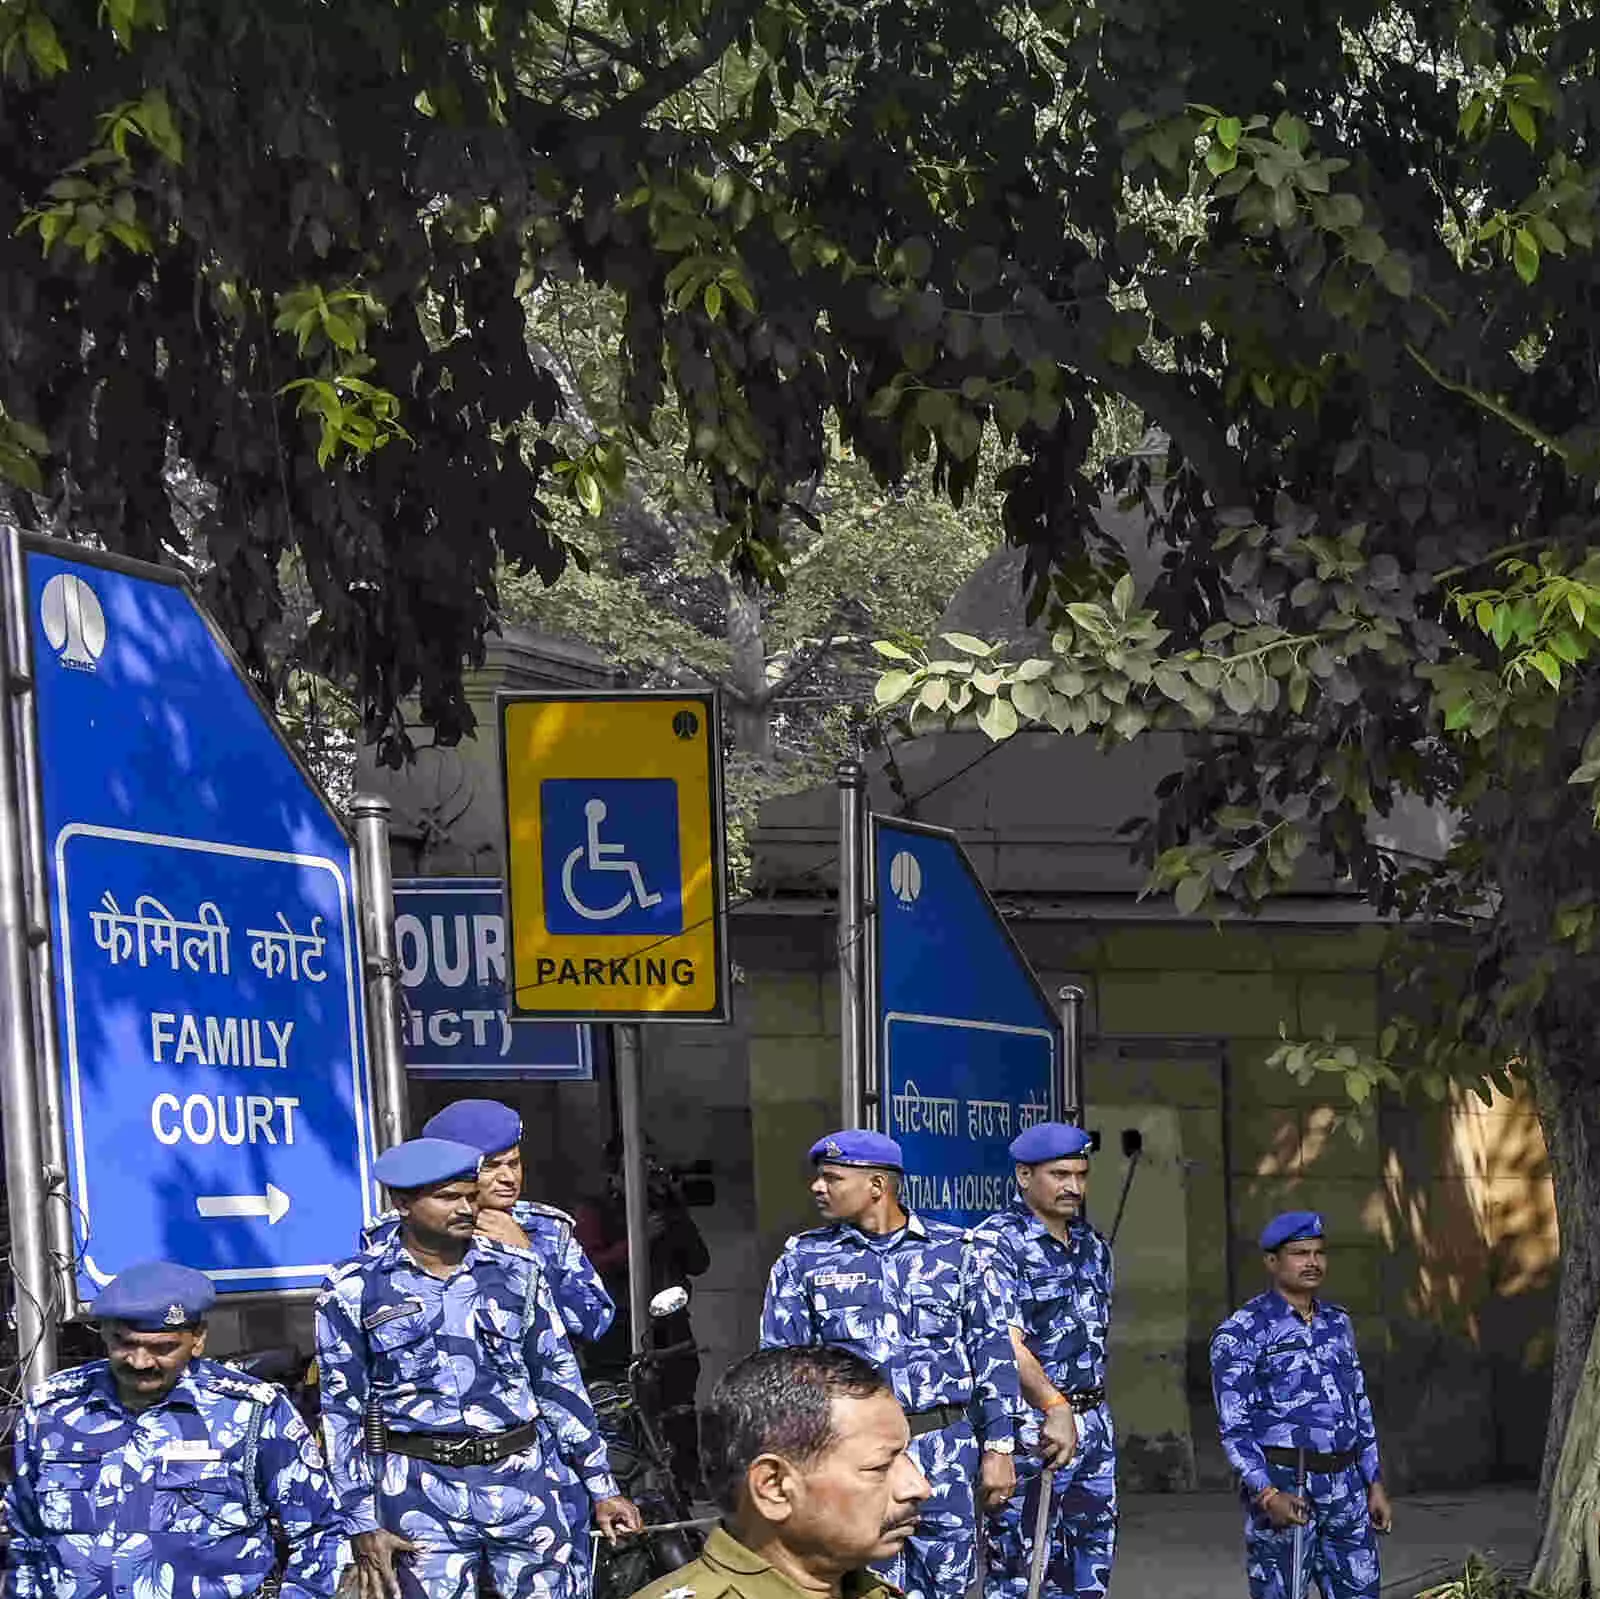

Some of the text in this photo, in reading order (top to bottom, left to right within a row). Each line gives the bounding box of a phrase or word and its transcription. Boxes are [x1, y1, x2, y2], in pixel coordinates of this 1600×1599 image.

[89, 890, 327, 982] फैमिली कोर्ट
[536, 958, 697, 987] PARKING
[151, 1012, 294, 1068] FAMILY
[152, 1093, 300, 1145] COURT
[892, 1079, 958, 1137] पटियाला
[954, 1175, 1001, 1210] HOUSE
